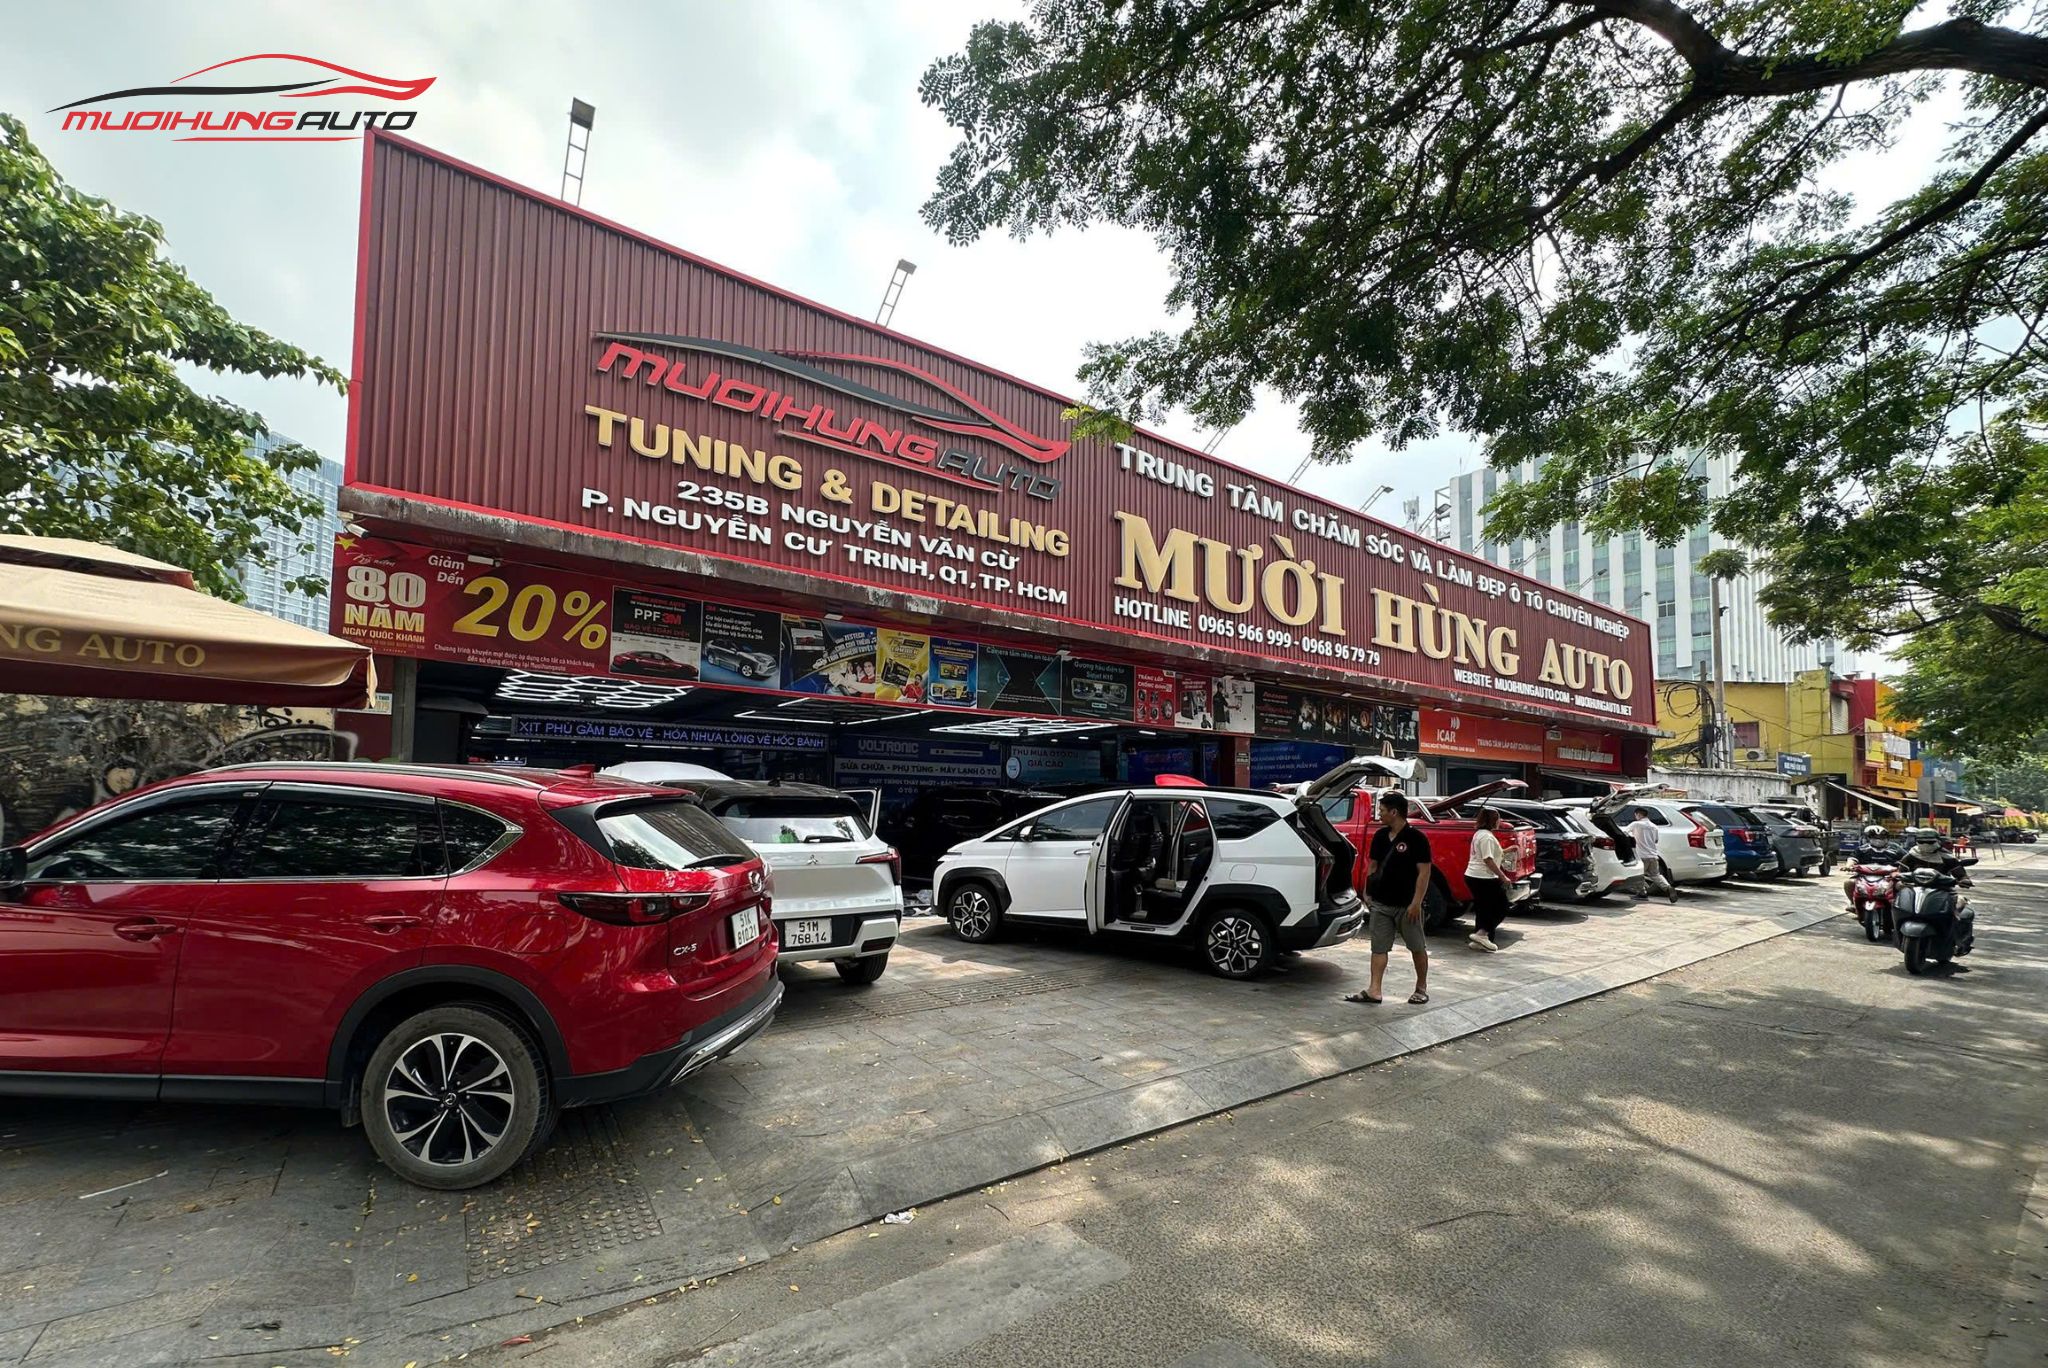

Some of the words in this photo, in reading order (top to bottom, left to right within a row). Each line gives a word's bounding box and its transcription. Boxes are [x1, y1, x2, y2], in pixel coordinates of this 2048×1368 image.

[585, 405, 803, 491] TUNING
[819, 468, 853, 504] &
[871, 480, 1070, 557] DETAILING
[677, 480, 769, 515] 235B
[780, 502, 911, 548] NGUYỄN
[918, 535, 975, 562] VĂN
[980, 549, 1020, 570] CỪ
[581, 487, 614, 513] P.
[623, 497, 772, 545] NGUYỄN
[784, 531, 833, 556] CƯ
[843, 544, 935, 581] TRINH,
[1017, 581, 1068, 605] HCM
[1115, 442, 1214, 498] TRUNG
[1226, 484, 1284, 522] TÂM
[1291, 509, 1360, 548] CHĂM
[1365, 532, 1405, 563] SÓC
[1409, 548, 1433, 574] VÀ
[1436, 559, 1473, 588] LÀM
[1476, 574, 1506, 600] ĐẸP
[1508, 582, 1521, 603] Ô
[1524, 590, 1543, 610] TÔ
[1546, 599, 1592, 627] CHUYÊN
[1593, 616, 1630, 642] NGHIỆP
[428, 554, 465, 571] Giảm
[346, 565, 427, 608] 80
[437, 571, 465, 586] Đến
[344, 602, 425, 633] NĂM
[452, 576, 608, 650] 20%
[634, 607, 661, 622] PPF
[662, 611, 682, 625] 3M
[1114, 510, 1346, 636] MƯỜI
[1370, 583, 1519, 676] HÙNG
[1540, 637, 1634, 700] AUTO
[76, 629, 206, 667] AUTO
[1198, 614, 1235, 637] 0965
[1237, 623, 1264, 643] 966
[1266, 628, 1292, 648] 999
[1301, 637, 1332, 657] 0968
[1334, 643, 1350, 660] 96
[1351, 647, 1366, 662] 79
[1366, 650, 1381, 666] 79
[858, 739, 919, 754] VOLTRONIC
[1436, 728, 1456, 743] ICAR
[740, 913, 752, 927] 51K
[798, 921, 819, 932] 51M
[673, 943, 697, 956] CX-5
[791, 932, 827, 945] 768.14
